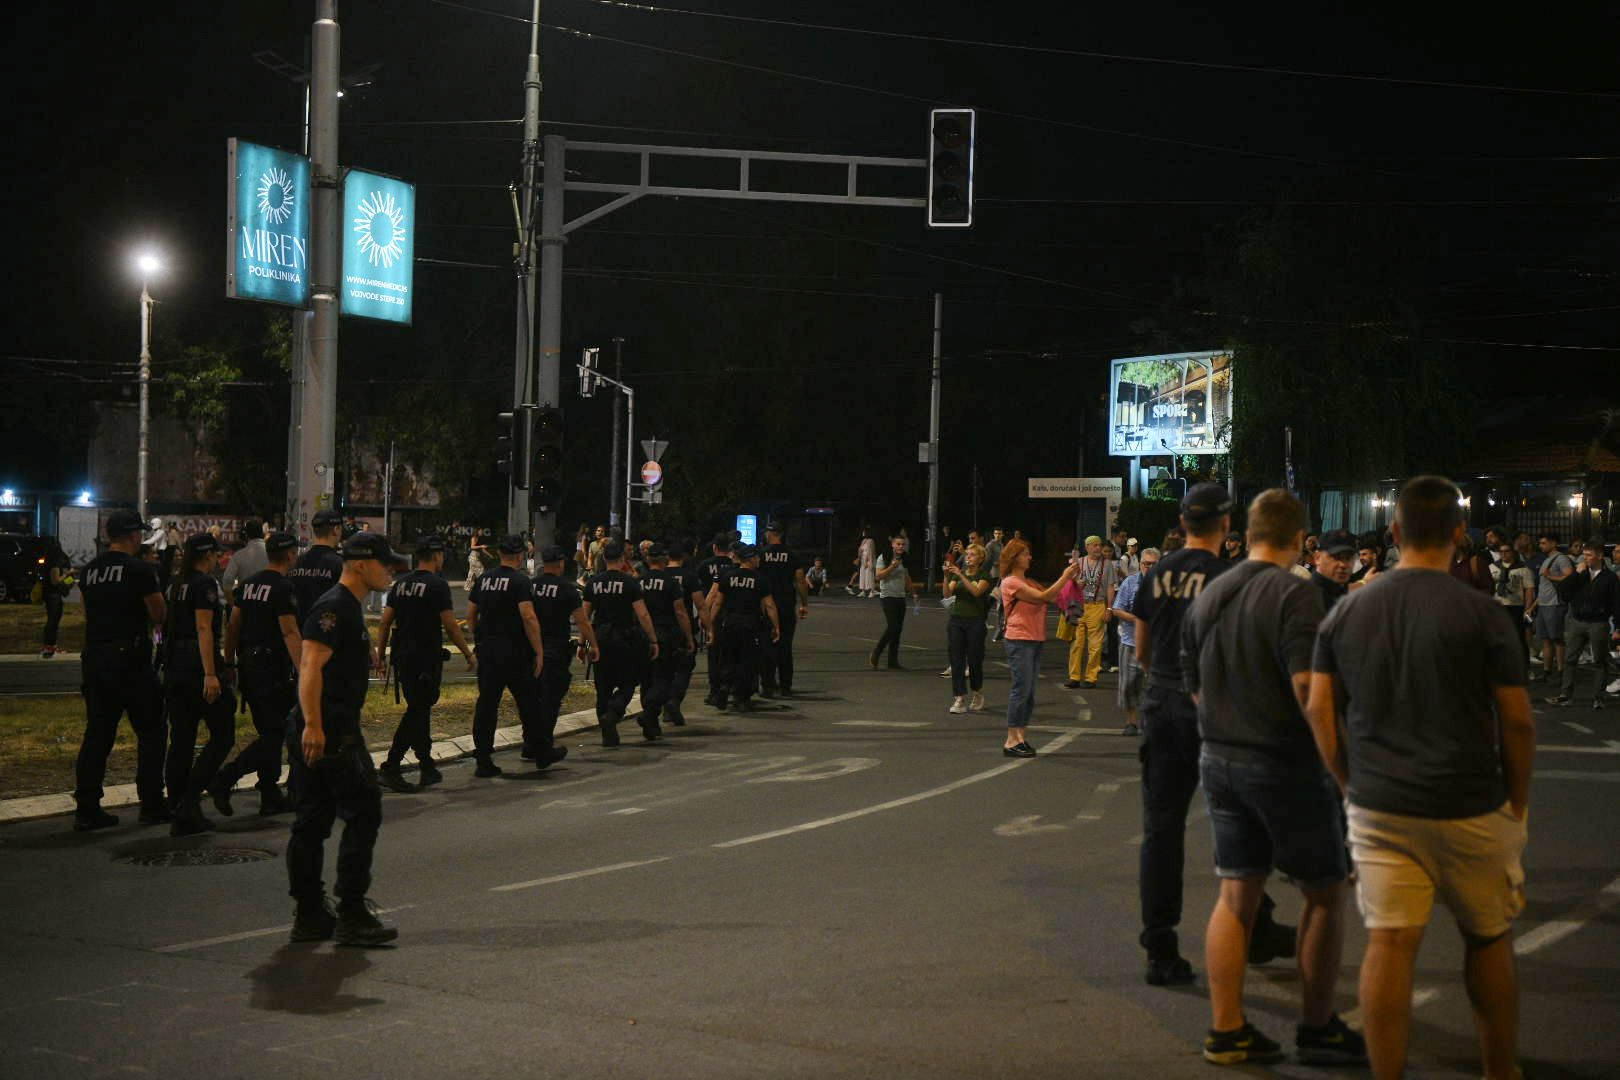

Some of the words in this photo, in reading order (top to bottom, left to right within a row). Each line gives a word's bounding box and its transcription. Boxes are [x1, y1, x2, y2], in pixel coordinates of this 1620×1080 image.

[242, 226, 306, 270] MIREN
[248, 265, 301, 284] POLIKLINIKA
[350, 290, 379, 301] VOJVODE
[379, 294, 396, 304] STEPE
[1093, 484, 1121, 492] ponešto
